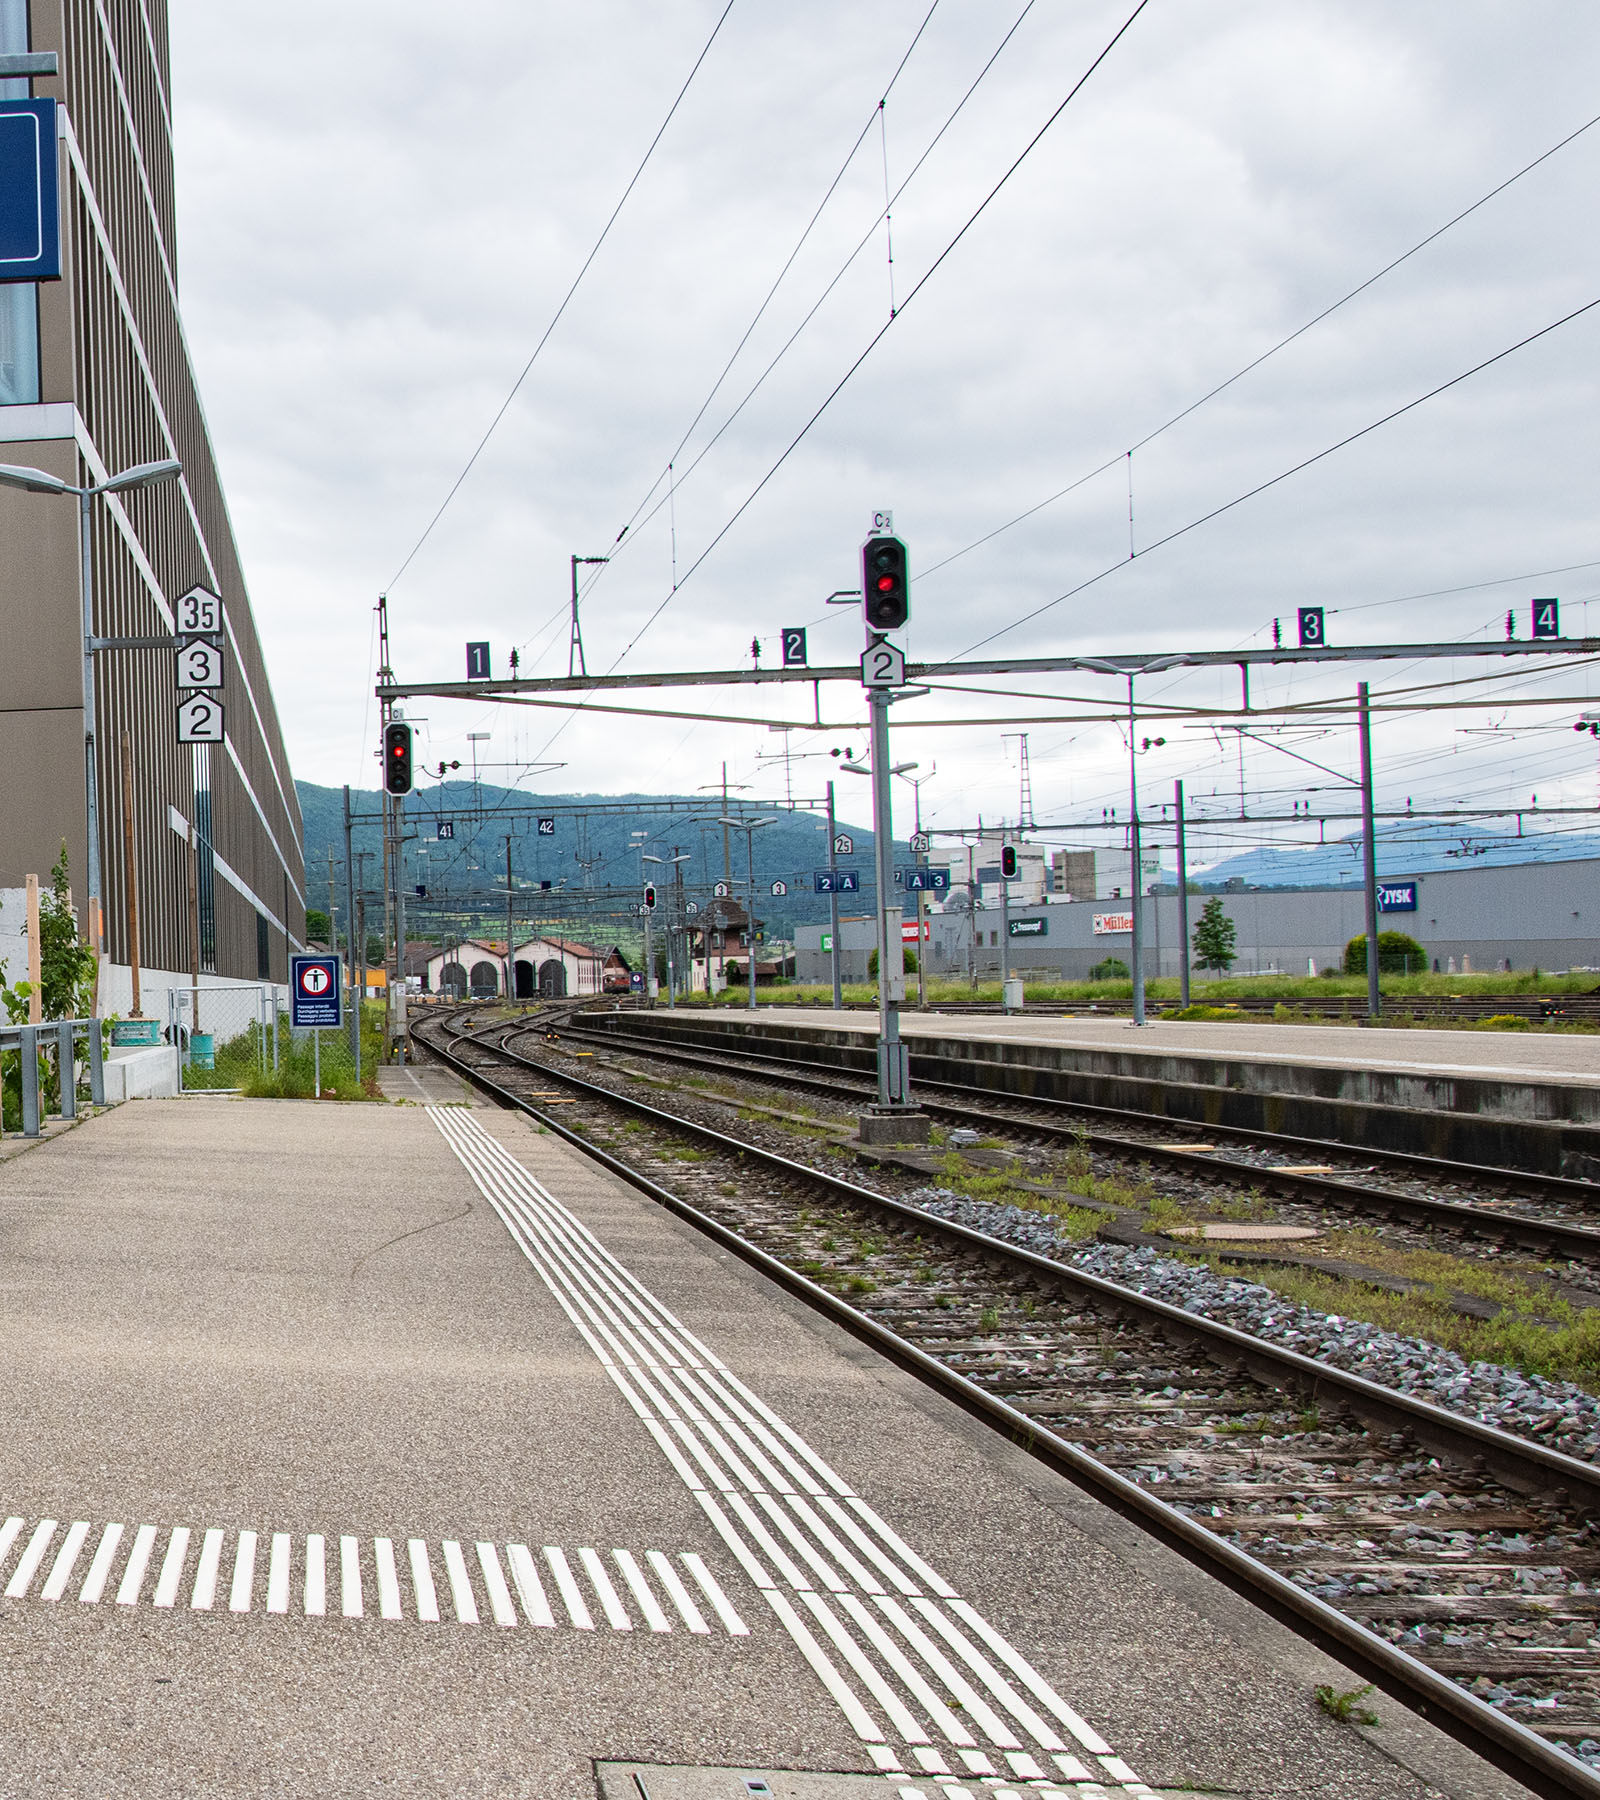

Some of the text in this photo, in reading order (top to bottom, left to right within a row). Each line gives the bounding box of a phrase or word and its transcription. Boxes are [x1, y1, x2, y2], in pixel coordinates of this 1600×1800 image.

[184, 595, 214, 630] 35
[1537, 604, 1555, 631] 4
[1304, 613, 1319, 640] 3
[787, 633, 802, 660] 2
[188, 650, 211, 682] 3
[472, 648, 482, 674] 1
[873, 652, 894, 681] 2
[190, 704, 212, 736] 2
[439, 824, 452, 838] 41
[539, 820, 554, 834] 42
[836, 838, 850, 853] 25
[913, 836, 927, 850] 25
[776, 883, 782, 894] 3
[821, 877, 853, 890] 2 A
[912, 875, 944, 887] A 3
[718, 884, 724, 896] 3
[1383, 888, 1412, 905] JYSK
[687, 903, 697, 914] 35
